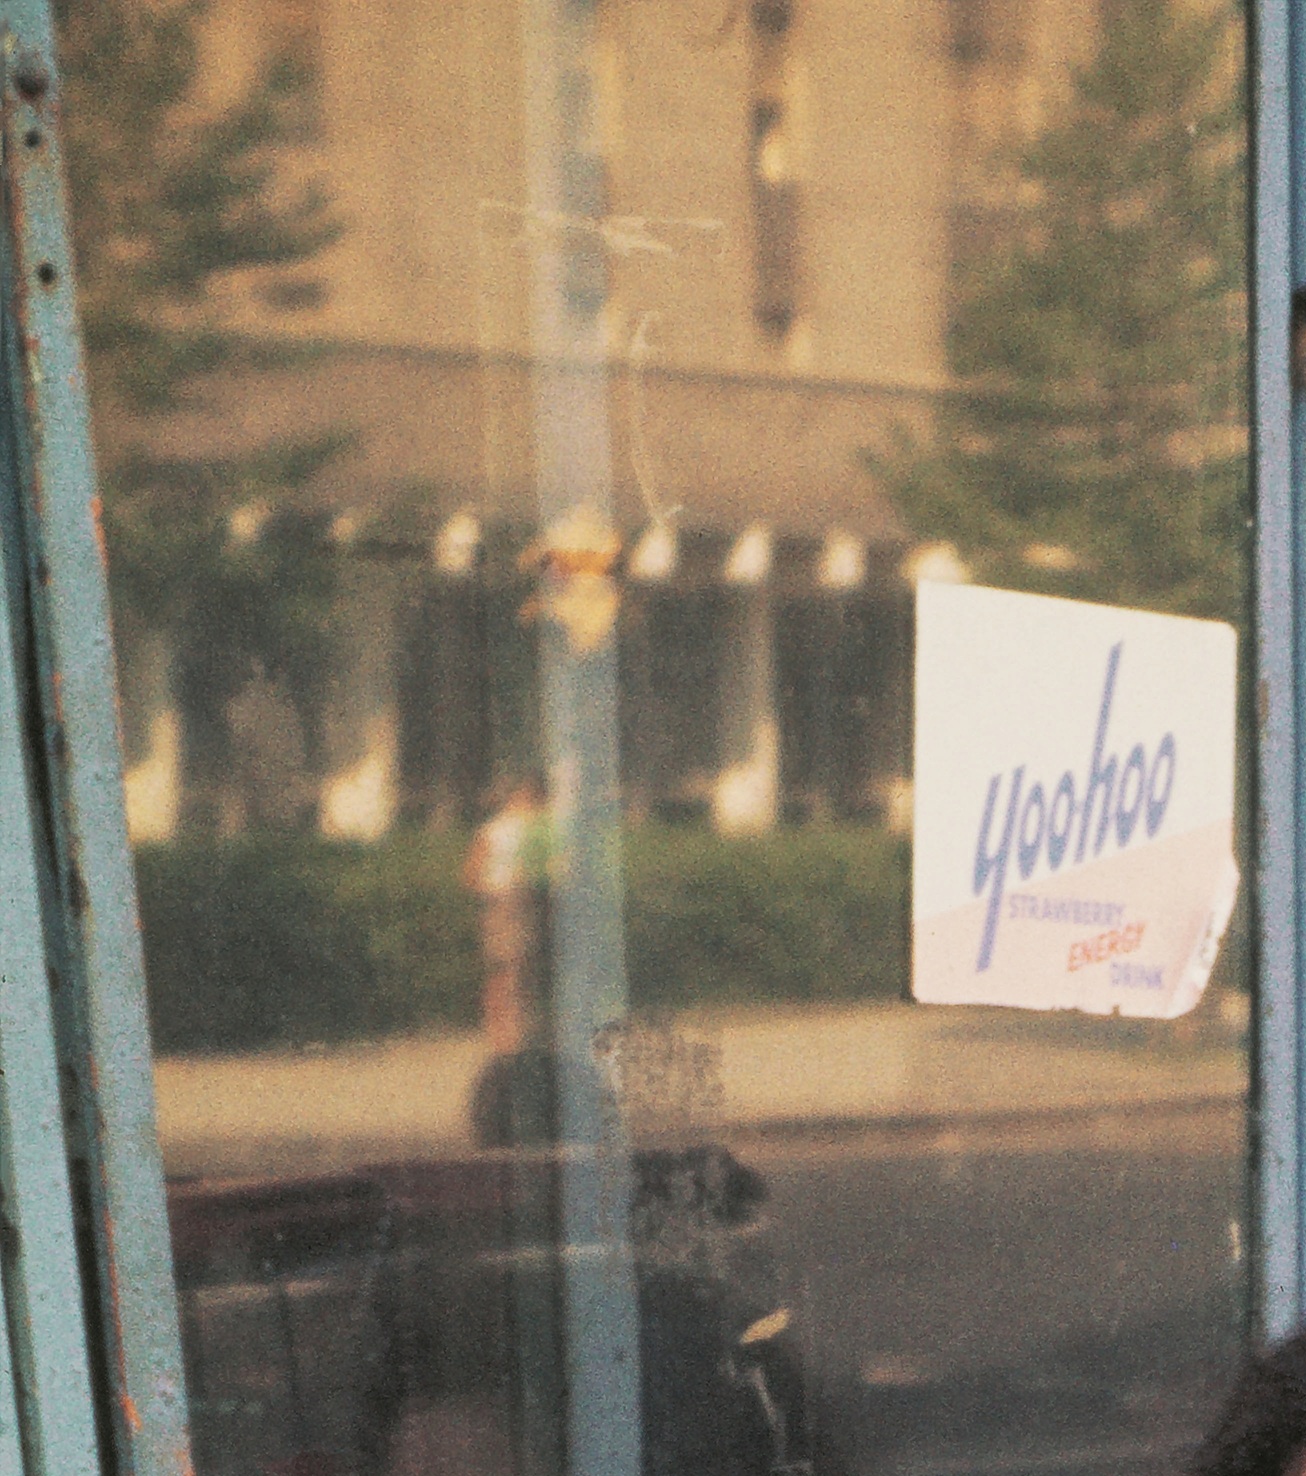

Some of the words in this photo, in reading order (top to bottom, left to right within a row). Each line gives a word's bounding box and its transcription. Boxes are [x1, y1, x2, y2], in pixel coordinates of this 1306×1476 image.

[1009, 894, 1126, 926] STRAWBERRY
[1067, 920, 1148, 972] ENERGY
[1110, 962, 1164, 990] DRINK
